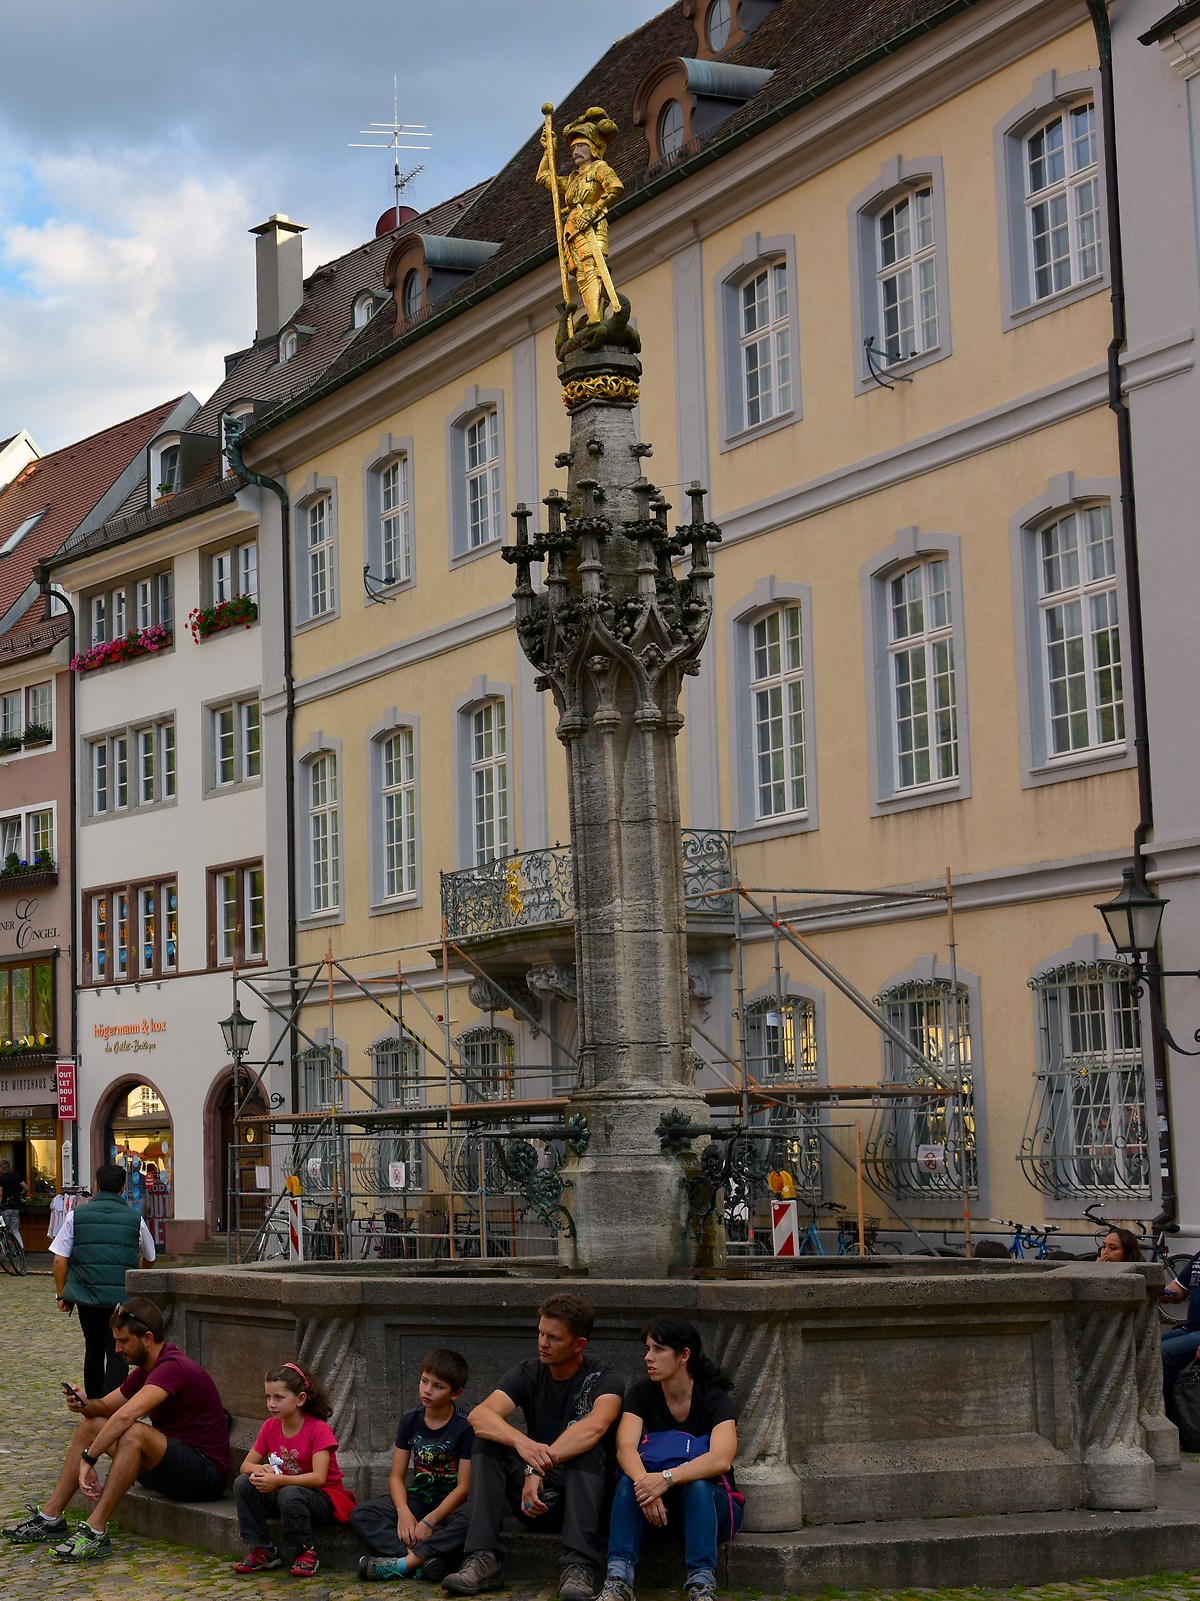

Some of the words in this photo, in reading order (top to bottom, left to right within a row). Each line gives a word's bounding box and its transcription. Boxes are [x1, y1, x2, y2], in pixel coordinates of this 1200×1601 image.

[15, 898, 60, 951] ENGEL
[93, 1024, 139, 1040] högermann
[141, 1018, 149, 1035] &
[150, 1018, 166, 1032] kox
[11, 1078, 47, 1091] WIRTSHAUS
